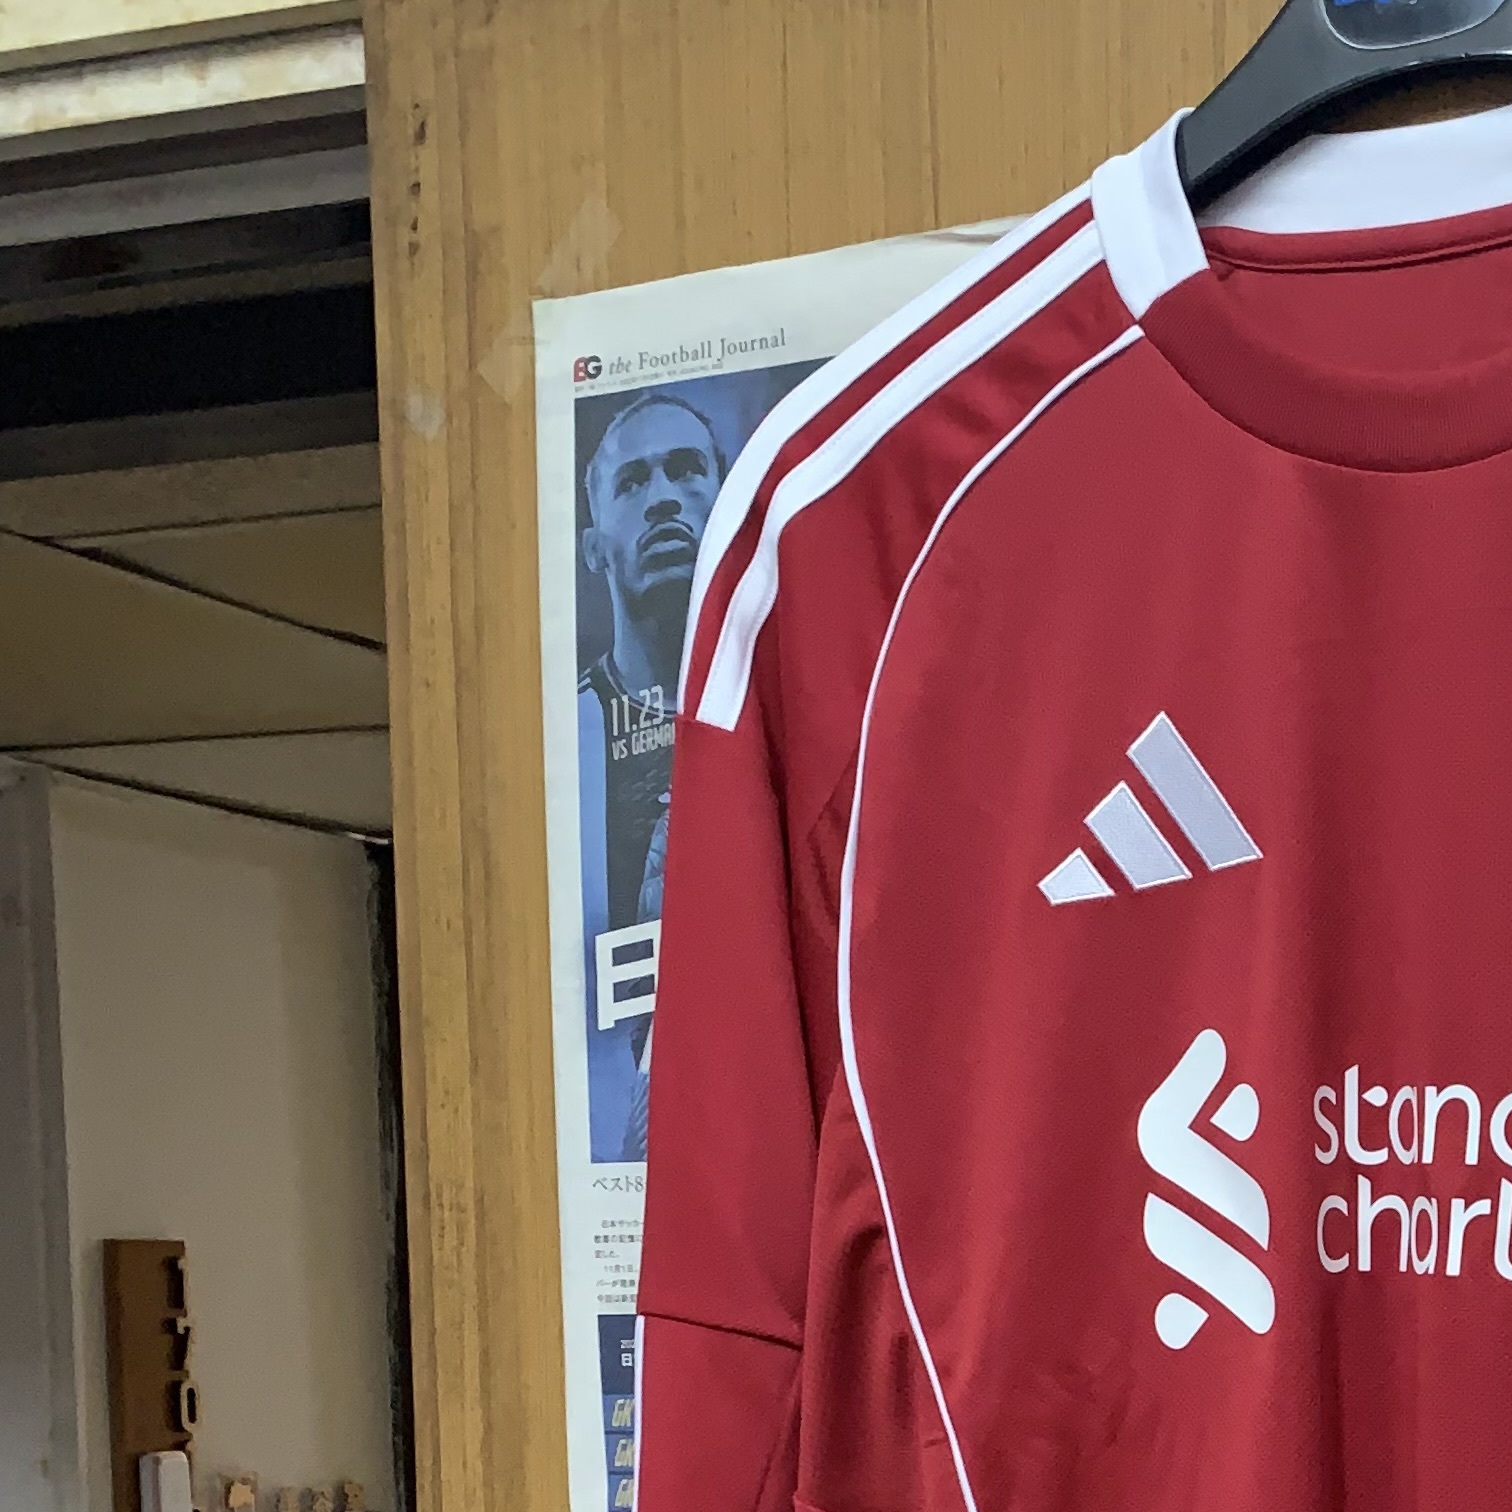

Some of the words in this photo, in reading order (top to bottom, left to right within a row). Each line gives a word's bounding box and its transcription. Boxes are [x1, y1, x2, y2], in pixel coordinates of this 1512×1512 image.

[608, 355, 633, 376] the
[638, 340, 712, 370] Football
[717, 327, 786, 362] Journal
[610, 684, 665, 737] 11.23
[611, 738, 628, 761] VS
